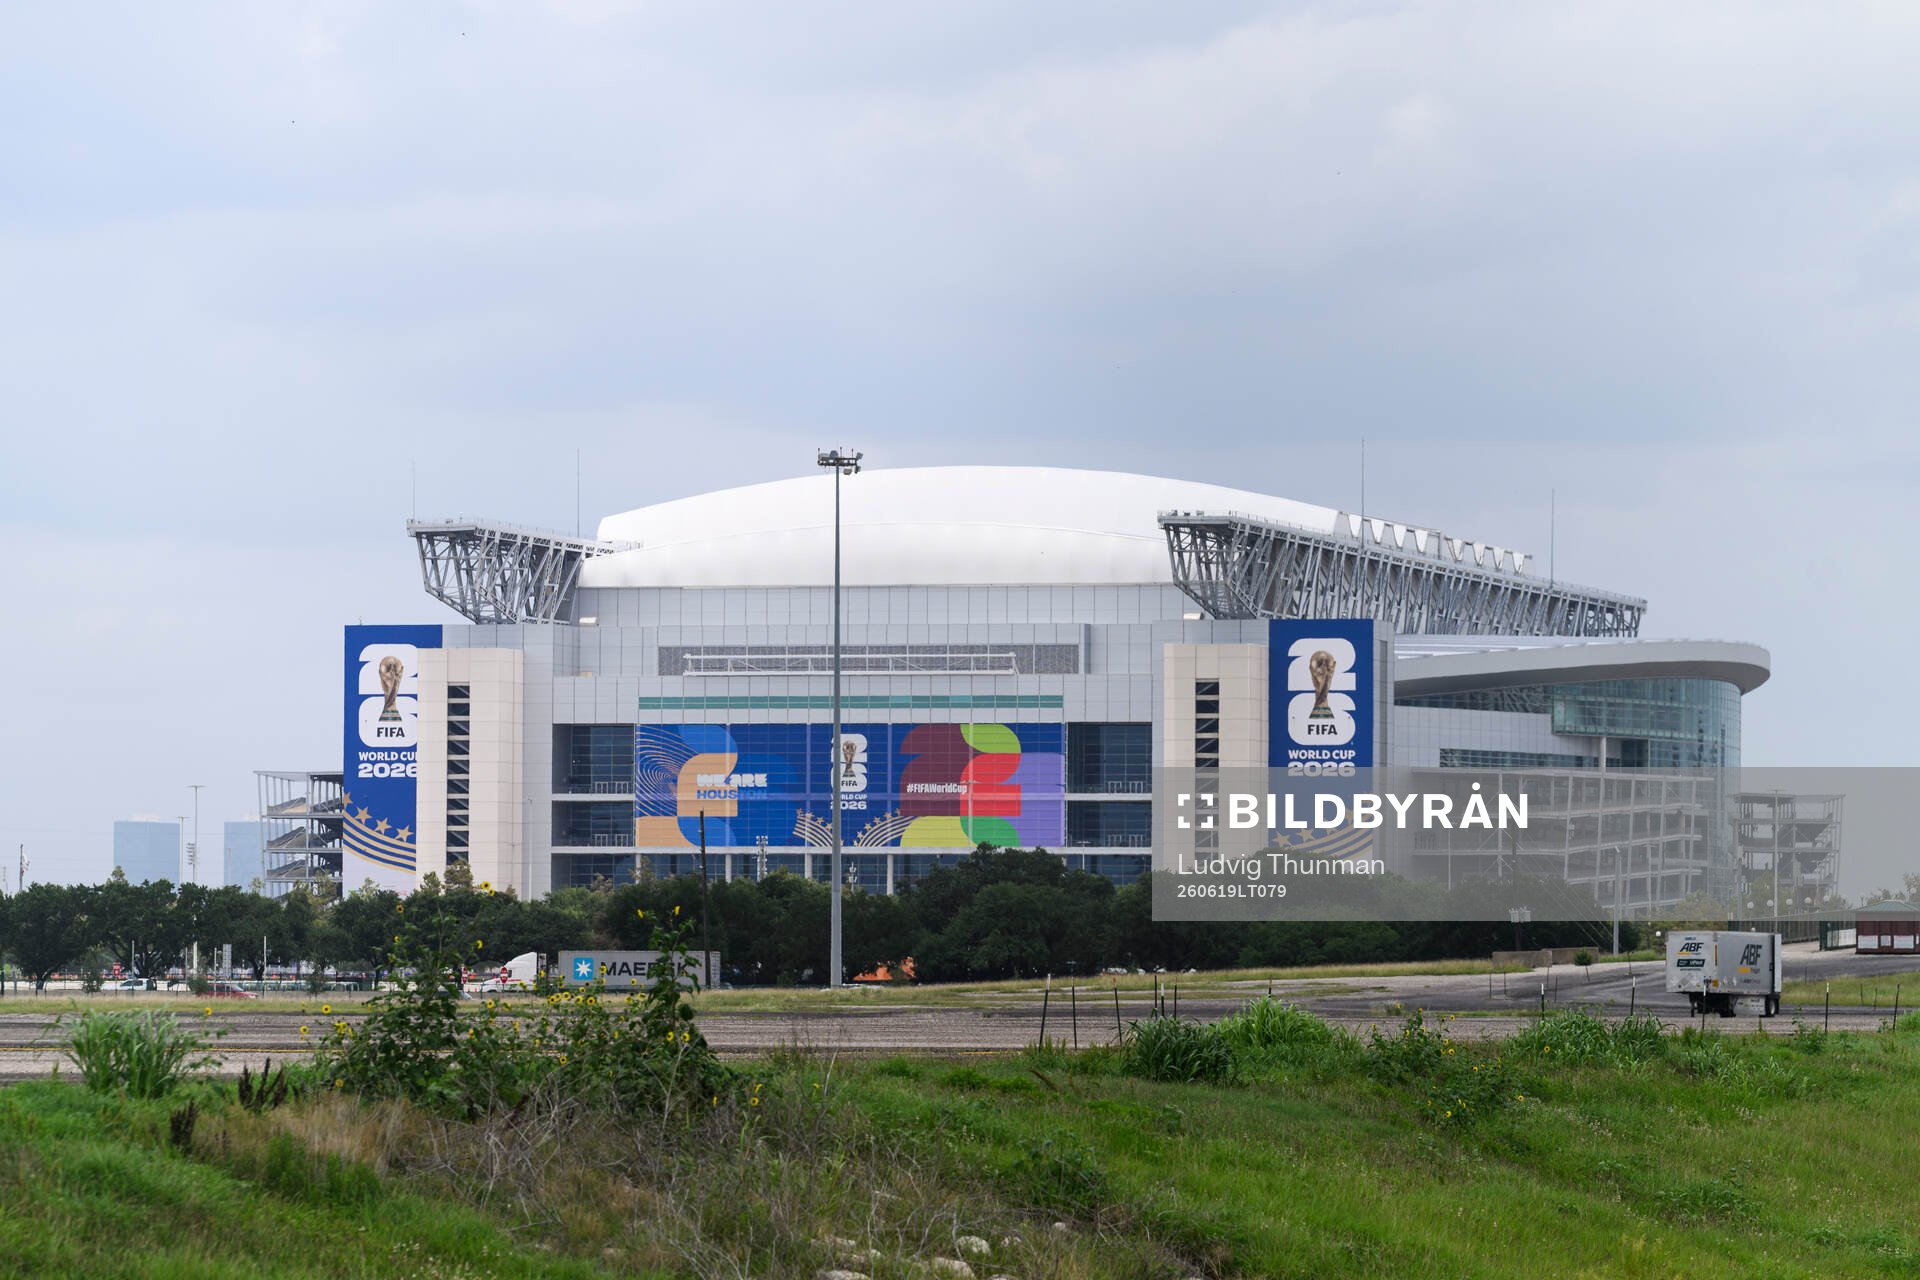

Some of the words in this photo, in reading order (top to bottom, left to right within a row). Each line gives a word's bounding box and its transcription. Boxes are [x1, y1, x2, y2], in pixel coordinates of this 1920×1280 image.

[376, 727, 405, 738] FIFA
[1307, 724, 1338, 735] FIFA
[358, 751, 399, 761] WORLD
[1288, 750, 1331, 760] WORLD
[1332, 750, 1356, 760] CUP
[358, 763, 417, 778] 2026
[1287, 761, 1356, 777] 2026
[906, 783, 968, 795] #FIFAWorldCup
[1680, 942, 1704, 952] ABF
[1740, 944, 1762, 965] ABF
[600, 962, 689, 976] MAEK
